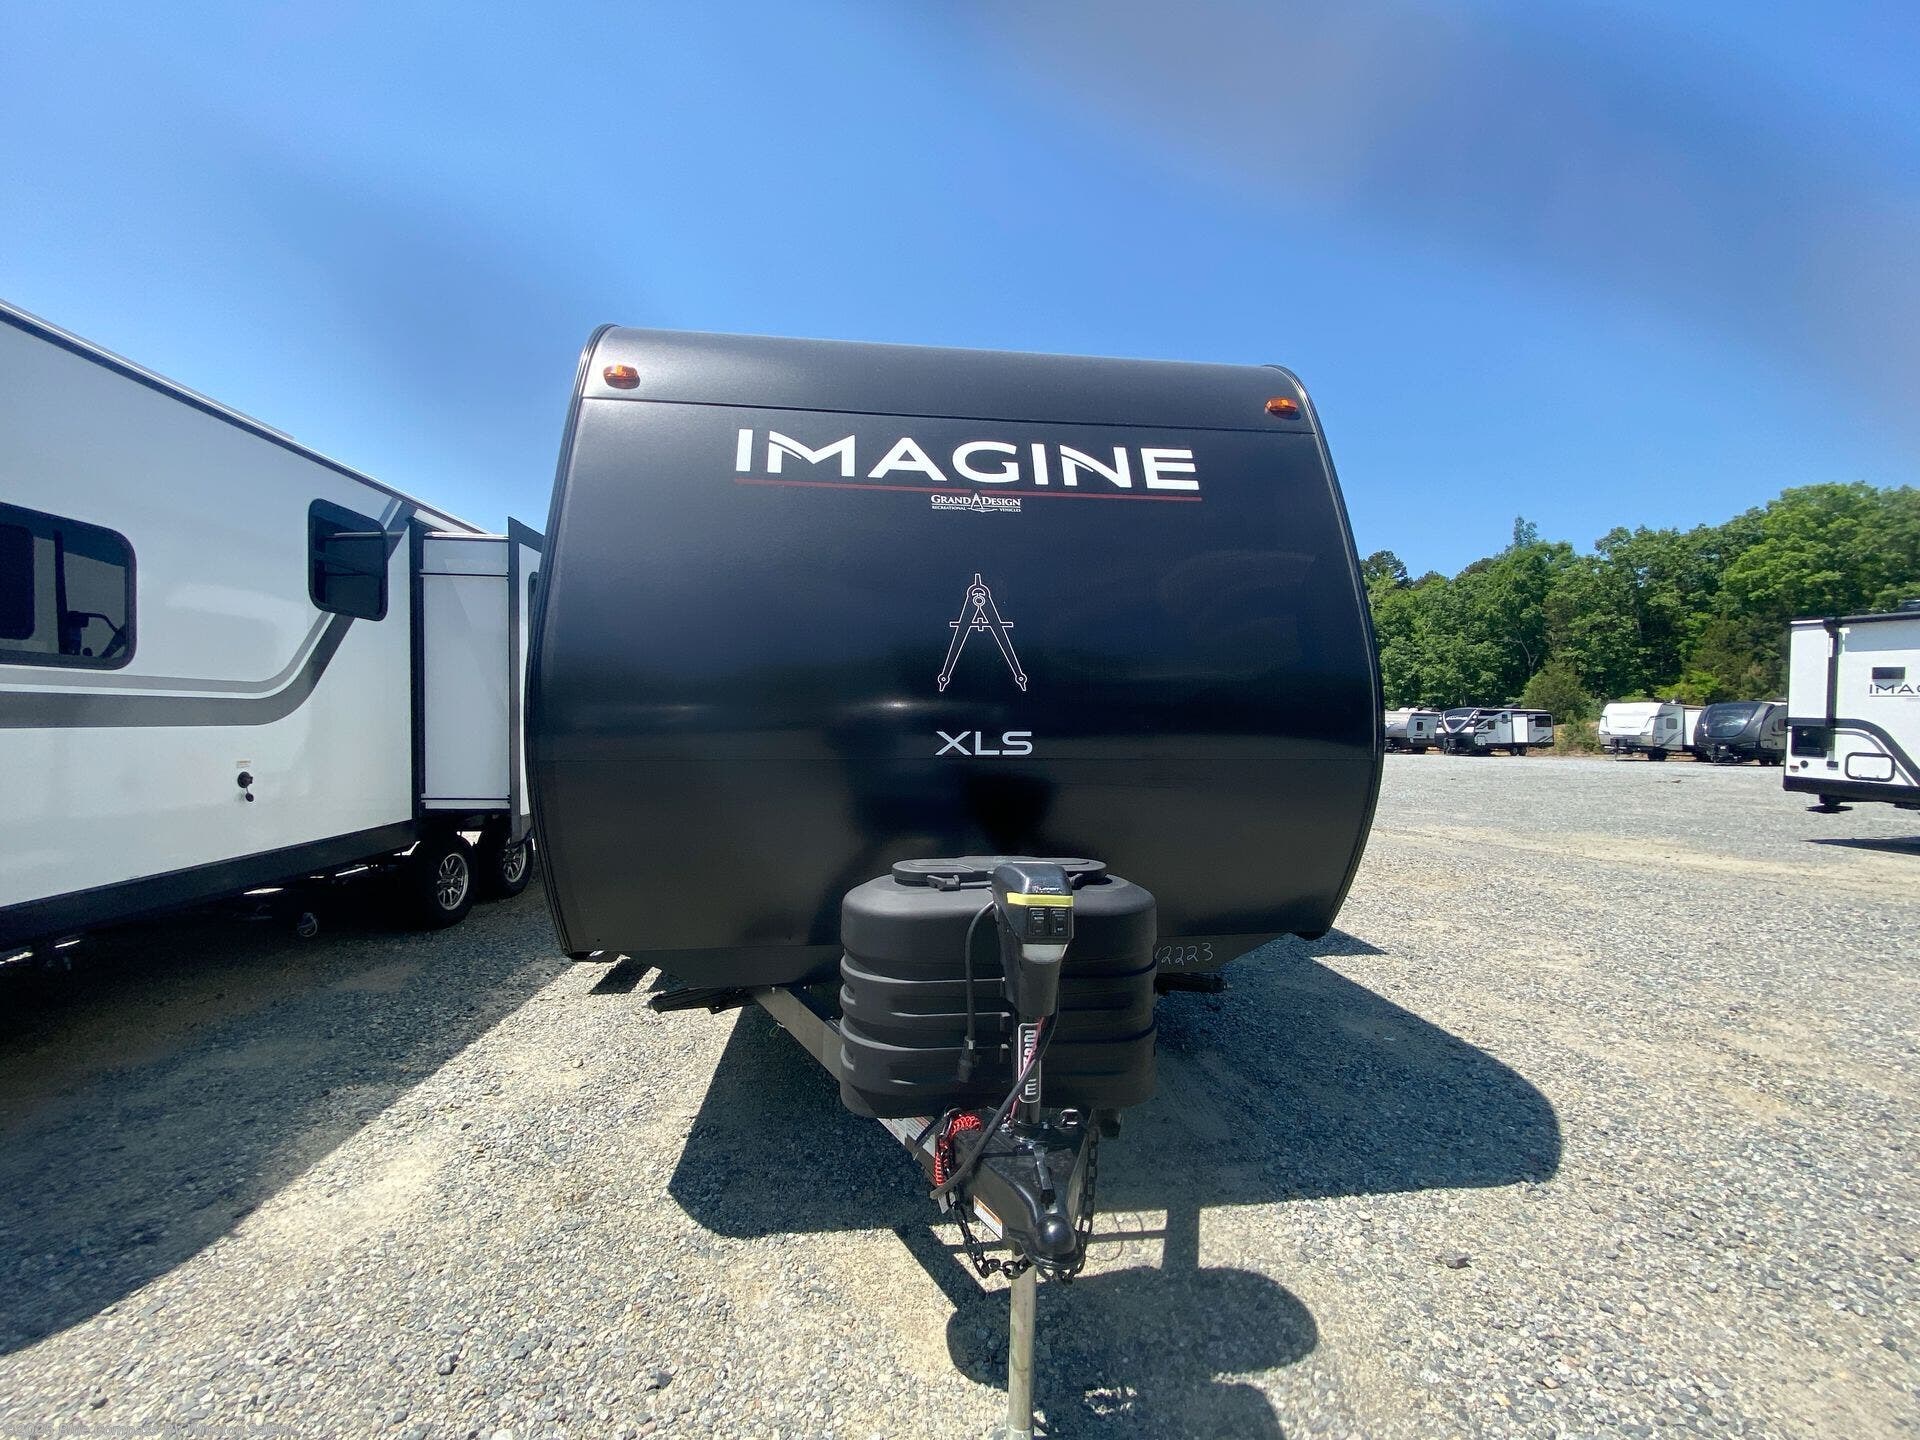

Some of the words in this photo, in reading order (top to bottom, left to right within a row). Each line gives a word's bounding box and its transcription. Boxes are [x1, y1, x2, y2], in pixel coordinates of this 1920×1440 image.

[735, 428, 1200, 490] IMAGINE
[982, 496, 1020, 506] DESIGN
[934, 730, 1033, 756] XLS
